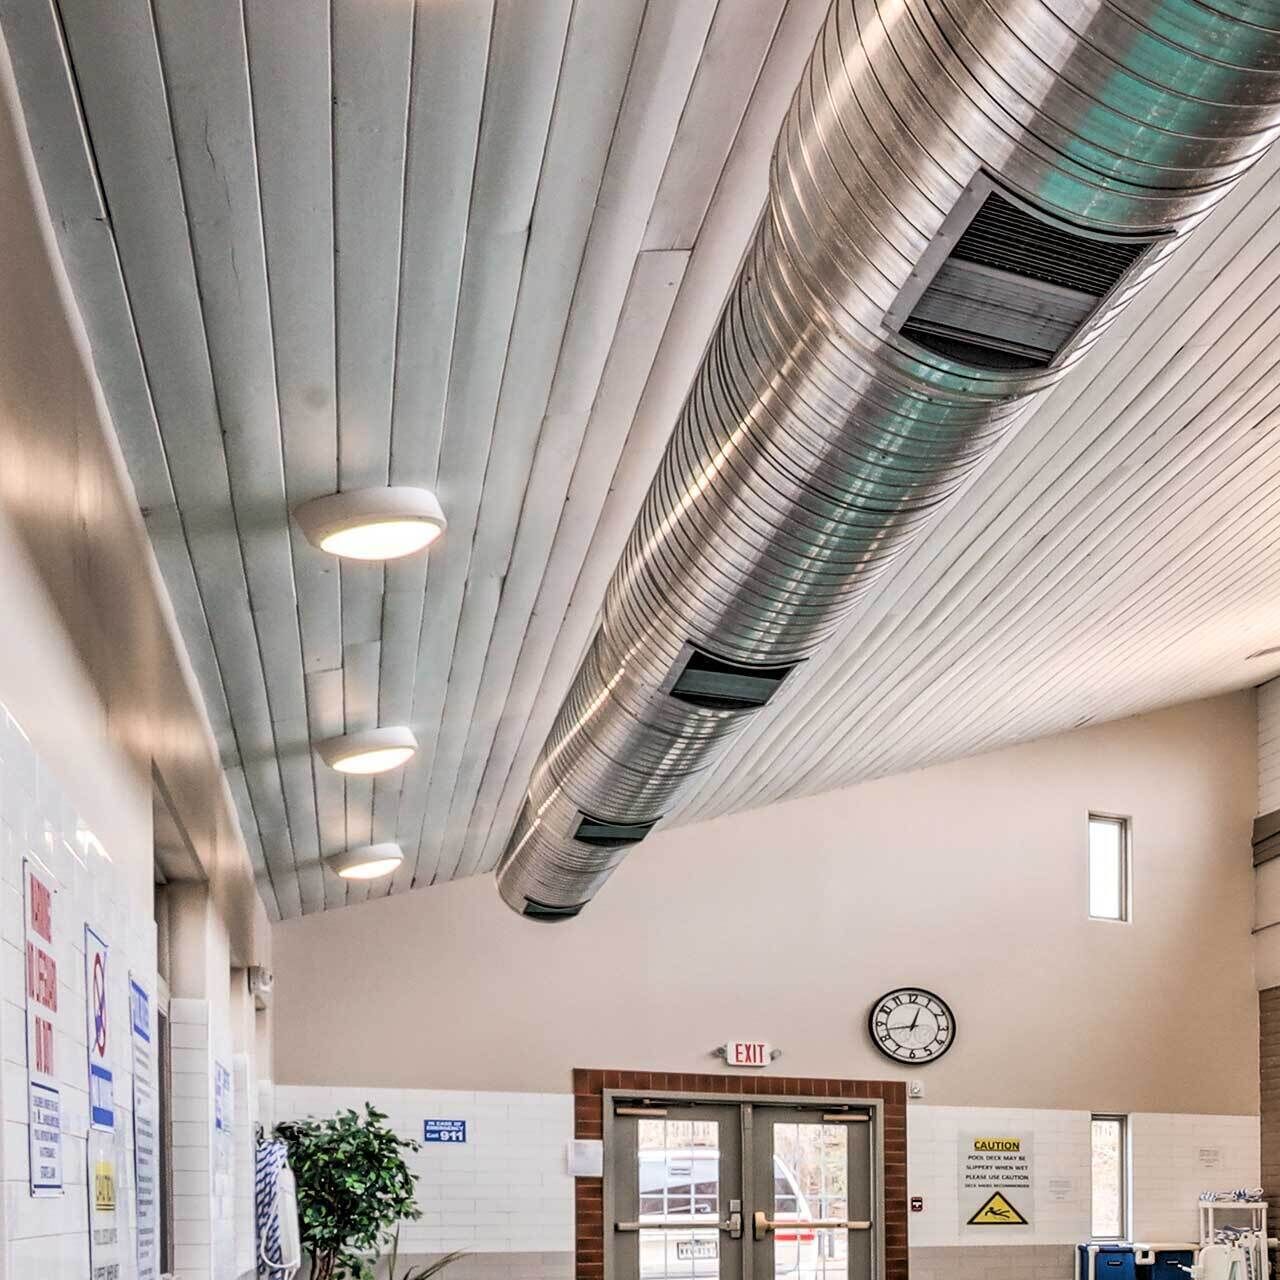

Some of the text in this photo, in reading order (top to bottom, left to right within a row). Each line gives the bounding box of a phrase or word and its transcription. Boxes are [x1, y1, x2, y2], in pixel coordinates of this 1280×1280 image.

[909, 994, 918, 1003] 12
[735, 1043, 765, 1063] EXIT
[910, 1049, 916, 1058] 6
[923, 1047, 932, 1056] 5
[440, 1131, 463, 1141] 911
[974, 1141, 1020, 1150] CAUTION
